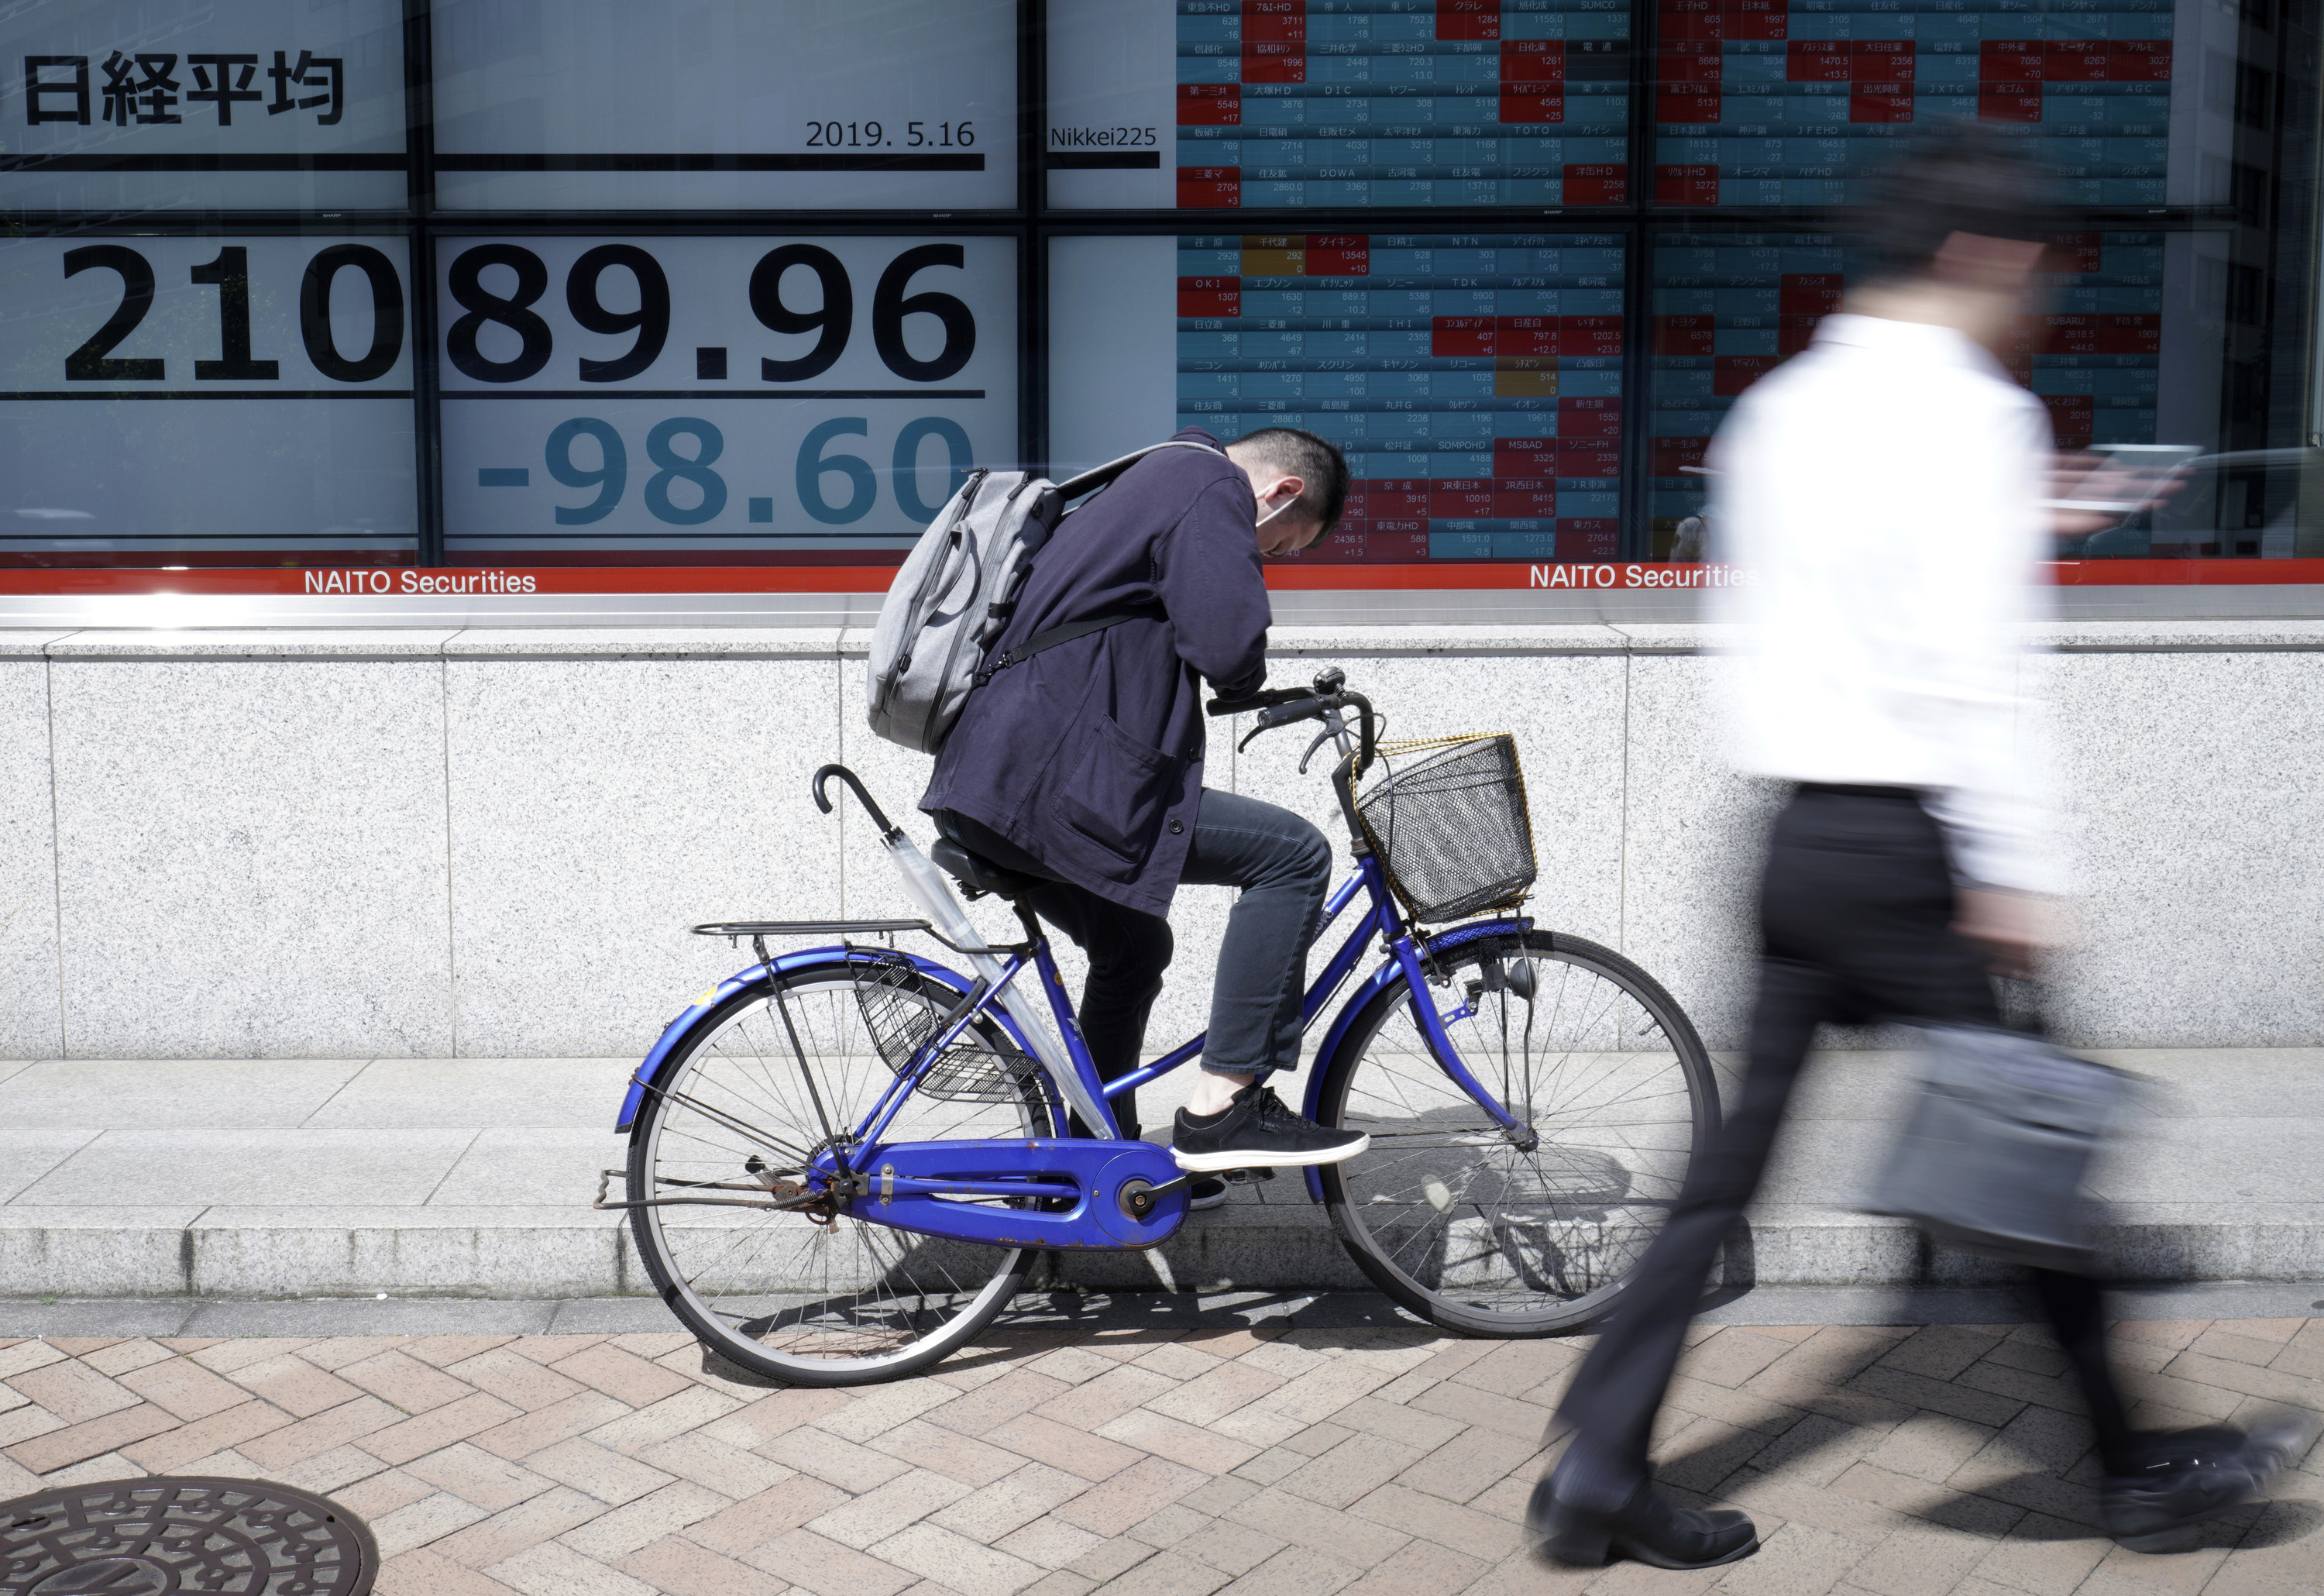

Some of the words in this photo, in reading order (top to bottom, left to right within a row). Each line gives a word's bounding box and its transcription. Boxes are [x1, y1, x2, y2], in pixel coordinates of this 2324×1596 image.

[1222, 16, 1239, 26] 628
[1282, 16, 1302, 25] 3711
[1346, 15, 1369, 25] 1796
[1409, 15, 1433, 25] 752.3
[1477, 15, 1498, 24] 1284
[1534, 14, 1563, 24] 1155.0
[1764, 15, 1786, 24] 1997
[1216, 58, 1239, 67] 9546
[1282, 58, 1304, 67] 1996
[1346, 57, 1368, 67] 2449
[1476, 57, 1497, 66] 2145
[1541, 56, 1561, 65] 1261
[1820, 56, 1849, 66] 1470.5
[1891, 56, 1913, 66] 2356
[2020, 55, 2042, 65] 7050
[2084, 55, 2106, 65] 6263
[2148, 56, 2171, 65] 3027
[23, 50, 346, 128] 日経平均
[1189, 86, 1227, 96] 第一三共
[1217, 100, 1239, 109] 5549
[1281, 99, 1304, 108] 3876
[1415, 98, 1432, 108] 308
[1539, 98, 1563, 107] 4565
[1697, 98, 1718, 108] 5131
[1889, 98, 1912, 107] 3340
[2019, 98, 2040, 107] 1962
[1050, 127, 1157, 147] Nikkei225
[1222, 142, 1239, 150] 769
[1281, 141, 1303, 150] 2714
[1539, 139, 1561, 149] 3820
[1216, 183, 1238, 191] 2704
[1273, 182, 1303, 191] 2860.0
[1346, 181, 1367, 191] 3360
[1409, 181, 1432, 191] 2788
[1466, 181, 1496, 191] 1371.0
[1603, 180, 1624, 189] 2258
[1695, 181, 1717, 190] 3272
[1286, 251, 1303, 260] 292
[1340, 251, 1367, 260] 13545
[1217, 292, 1239, 301] 1307
[1281, 292, 1302, 301] 1630
[1342, 291, 1367, 301] 889.5
[1472, 291, 1494, 300] 8900
[62, 243, 976, 384] 21089.96
[1222, 333, 1238, 342] 368
[1280, 333, 1302, 342] 4649
[1477, 332, 1494, 342] 407
[1533, 332, 1557, 340] 797.8
[1592, 332, 1621, 340] 1202.5
[1690, 331, 1712, 340] 6578
[2065, 330, 2095, 339] 2618.5
[1217, 374, 1237, 383] 1411
[1343, 373, 1366, 383] 4950
[1539, 373, 1556, 381] 514
[1208, 414, 1238, 424] 1578.5
[1344, 414, 1365, 423] 1182
[1598, 412, 1619, 421] 1550
[2070, 411, 2092, 419] 2015
[1533, 453, 1555, 462] 3325
[1597, 453, 1618, 462] 2339
[478, 416, 975, 526] -98.60
[1465, 494, 1490, 503] 10010
[1532, 494, 1554, 502] 8415
[1334, 535, 1364, 544] 2436.5
[1411, 535, 1427, 543] 588
[1461, 534, 1490, 543] 1531.0
[1530, 565, 1616, 587] NAITO
[1625, 564, 1761, 587] Securities
[304, 571, 390, 593] NAITO
[400, 571, 537, 593] Securities
